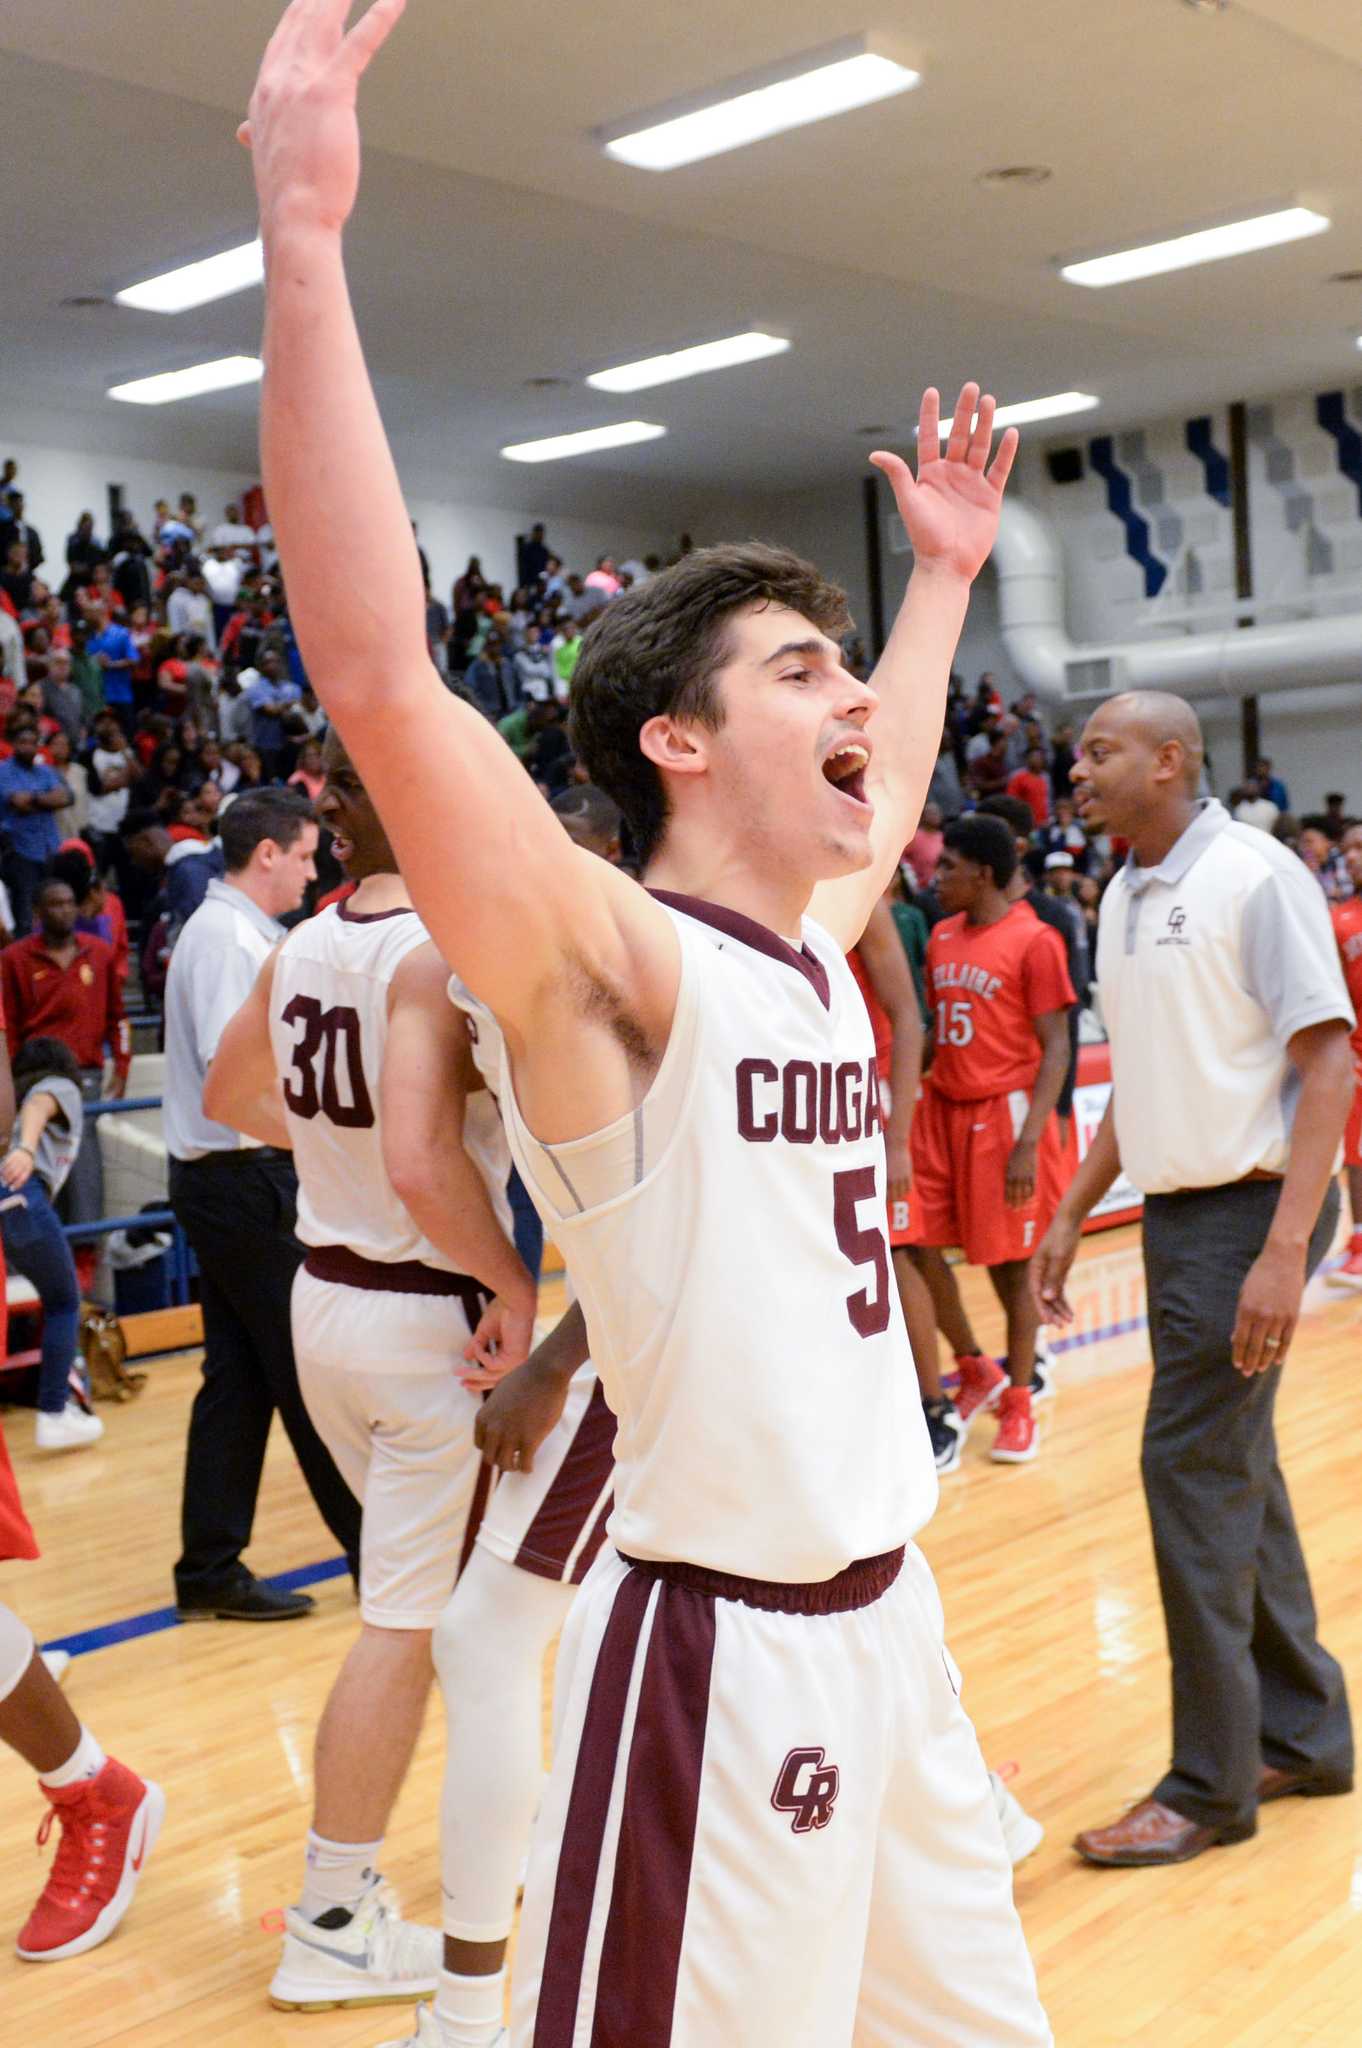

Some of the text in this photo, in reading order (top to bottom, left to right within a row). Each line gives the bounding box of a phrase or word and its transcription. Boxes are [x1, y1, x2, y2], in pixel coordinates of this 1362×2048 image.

[282, 993, 375, 1129] 30
[937, 1000, 975, 1047] 15
[833, 1165, 890, 1339] 5
[893, 1201, 909, 1231] B
[770, 1747, 840, 1834] CR
